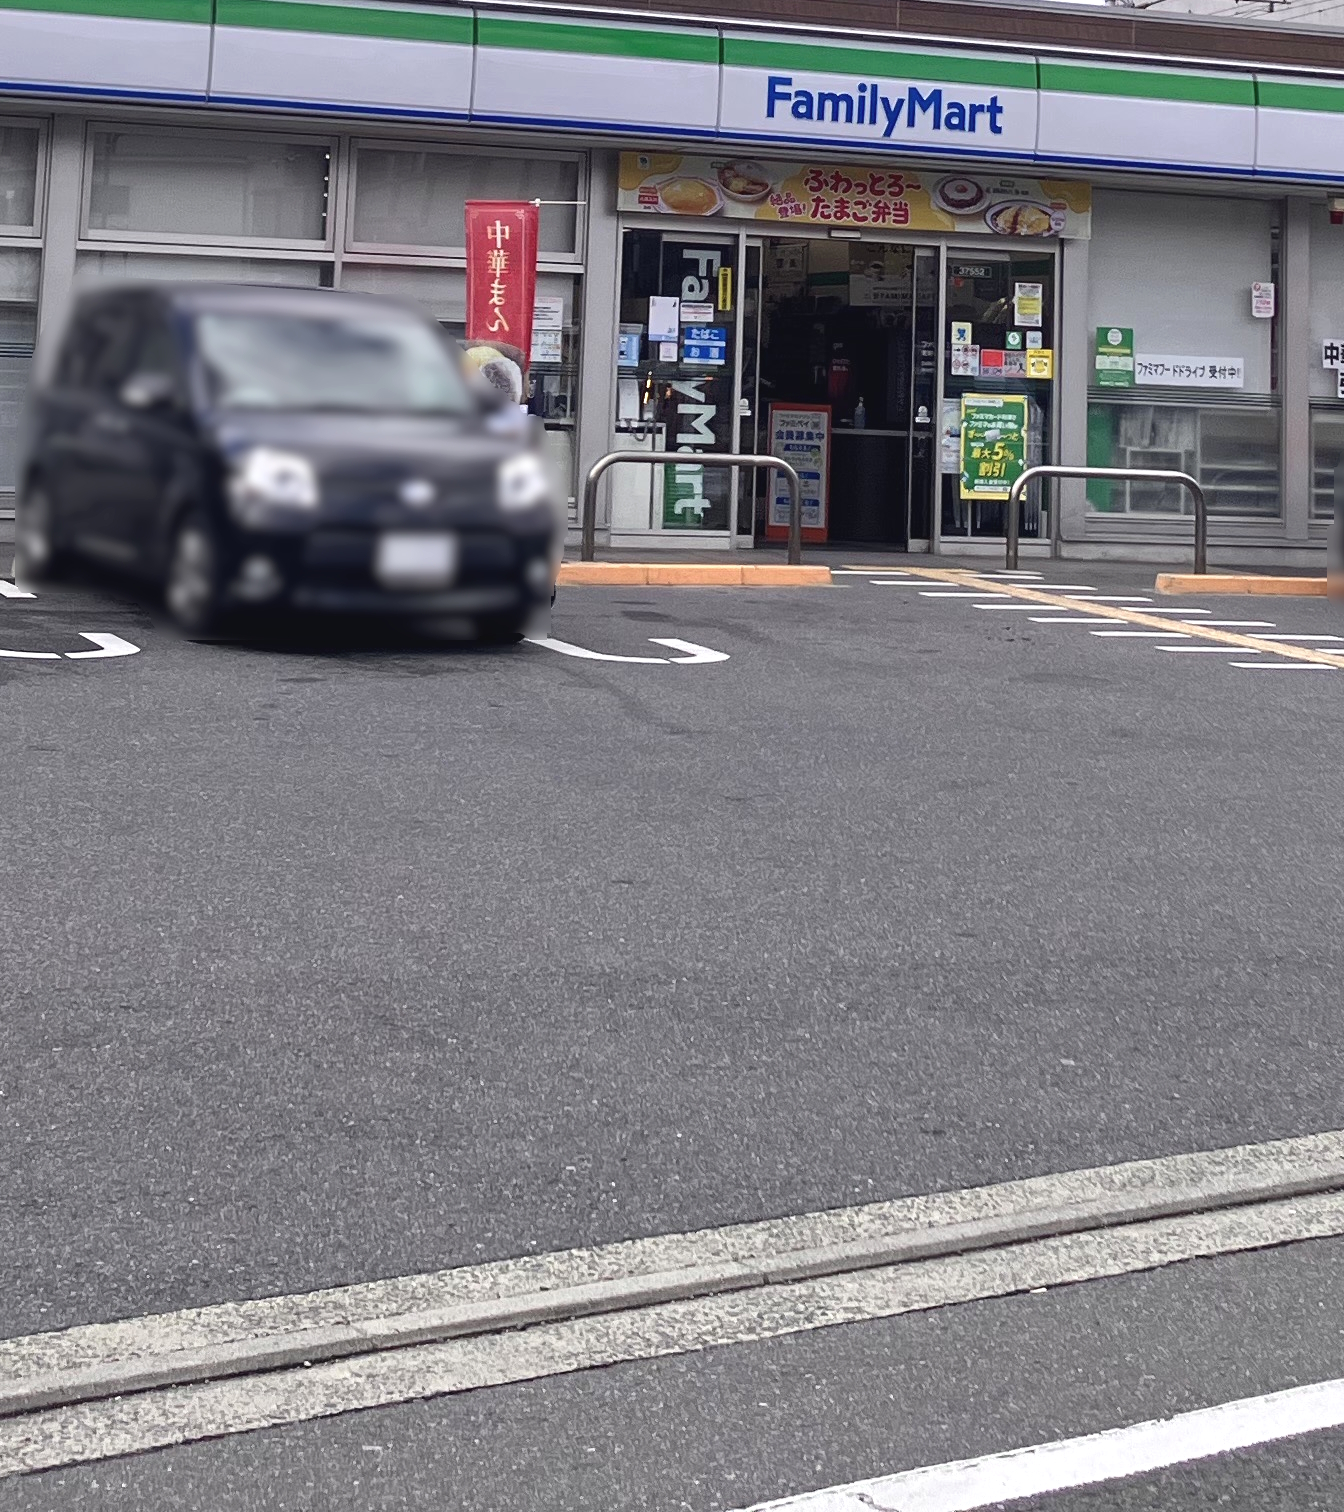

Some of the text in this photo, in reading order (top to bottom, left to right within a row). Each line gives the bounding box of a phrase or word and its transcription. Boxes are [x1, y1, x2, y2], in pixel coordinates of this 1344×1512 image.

[766, 75, 1003, 138] FamilyMart
[810, 195, 910, 225] たまご弁当
[486, 219, 510, 332] 中華まん
[690, 328, 720, 339] たばこ
